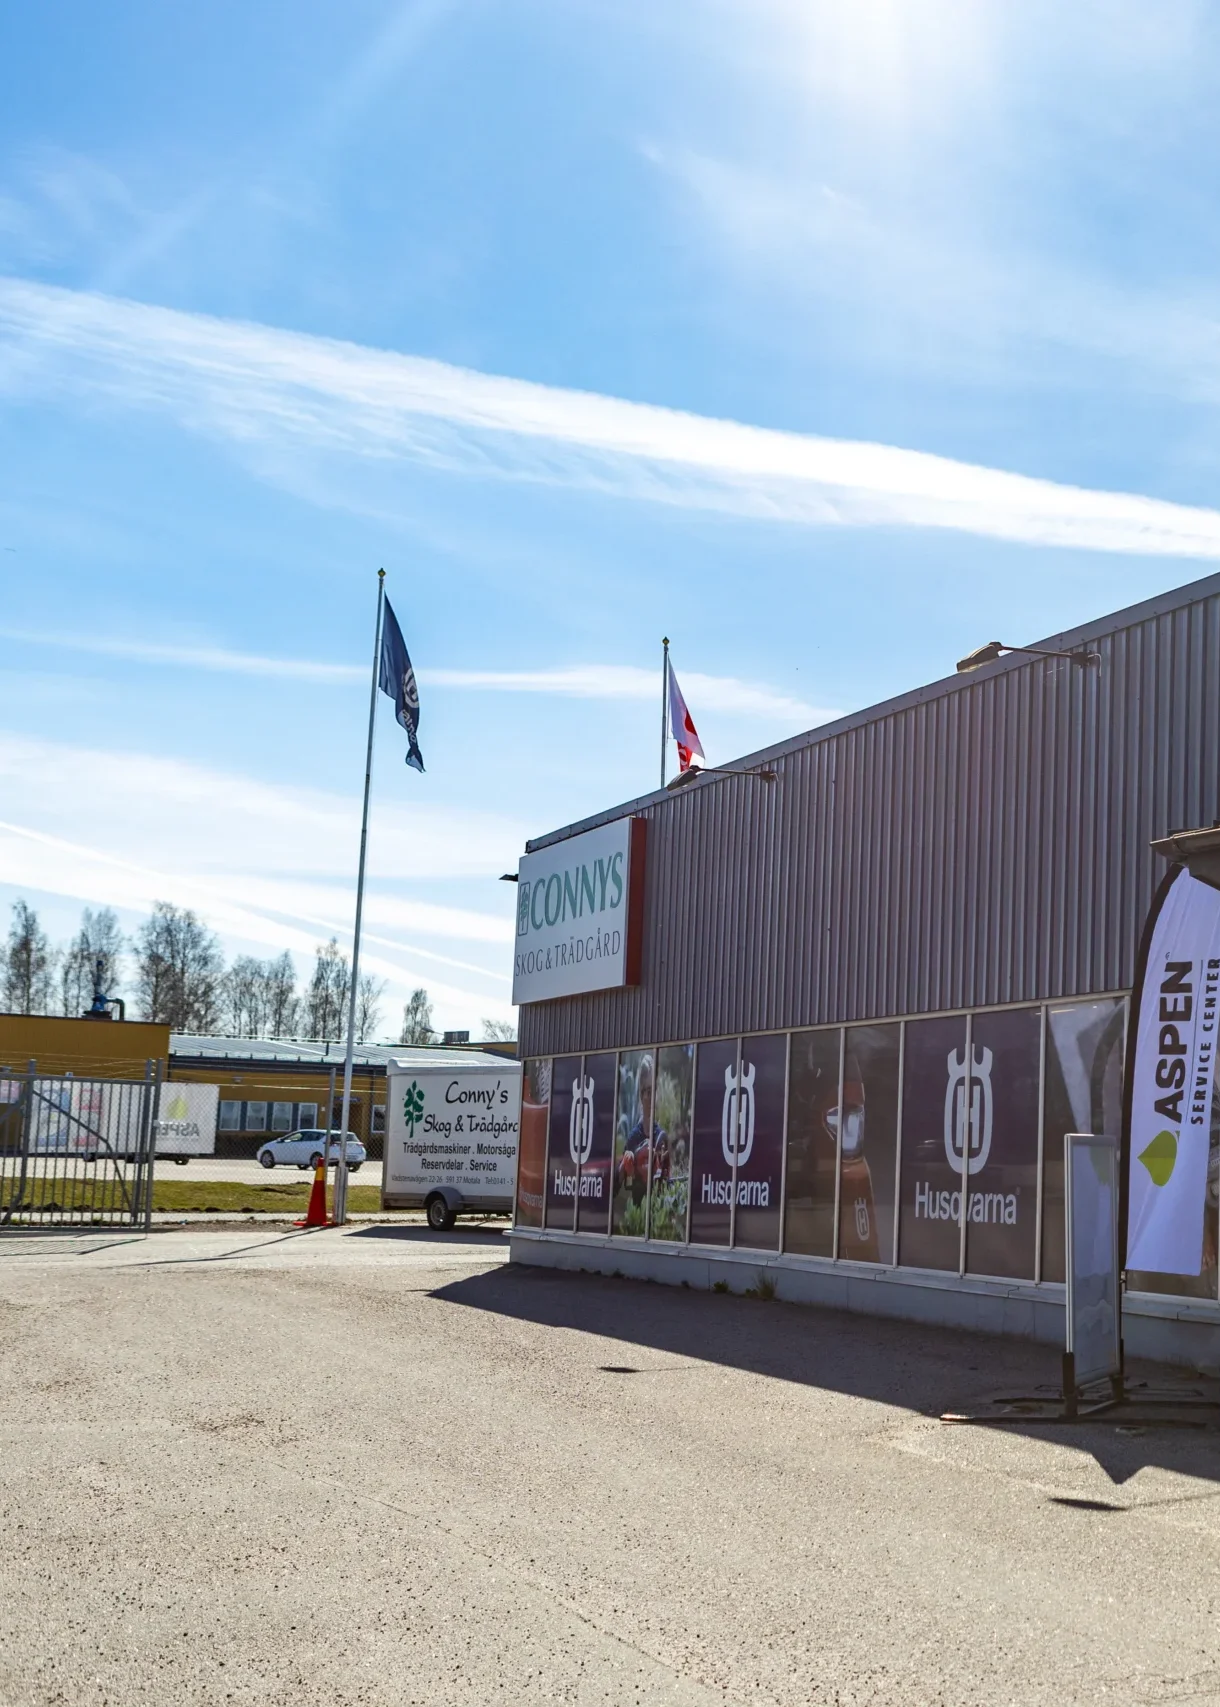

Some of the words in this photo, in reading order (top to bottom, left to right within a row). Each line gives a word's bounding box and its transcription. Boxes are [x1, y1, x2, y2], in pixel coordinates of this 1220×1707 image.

[530, 851, 623, 931] CONNYS
[515, 948, 544, 977] SKOG
[545, 947, 552, 970] &
[555, 927, 621, 968] TRÄDGÅRD
[1154, 961, 1193, 1124] ASPEN
[1191, 1042, 1211, 1125] SERVICE
[1202, 958, 1220, 1032] CENTER
[445, 1080, 508, 1110] Conny's
[423, 1114, 451, 1138] Skog
[455, 1115, 464, 1132] &
[403, 1142, 471, 1156] Trädgårdsmaskiner
[477, 1143, 516, 1158] Motorsåga
[421, 1158, 464, 1171] Reservdelar
[470, 1159, 497, 1172] Service
